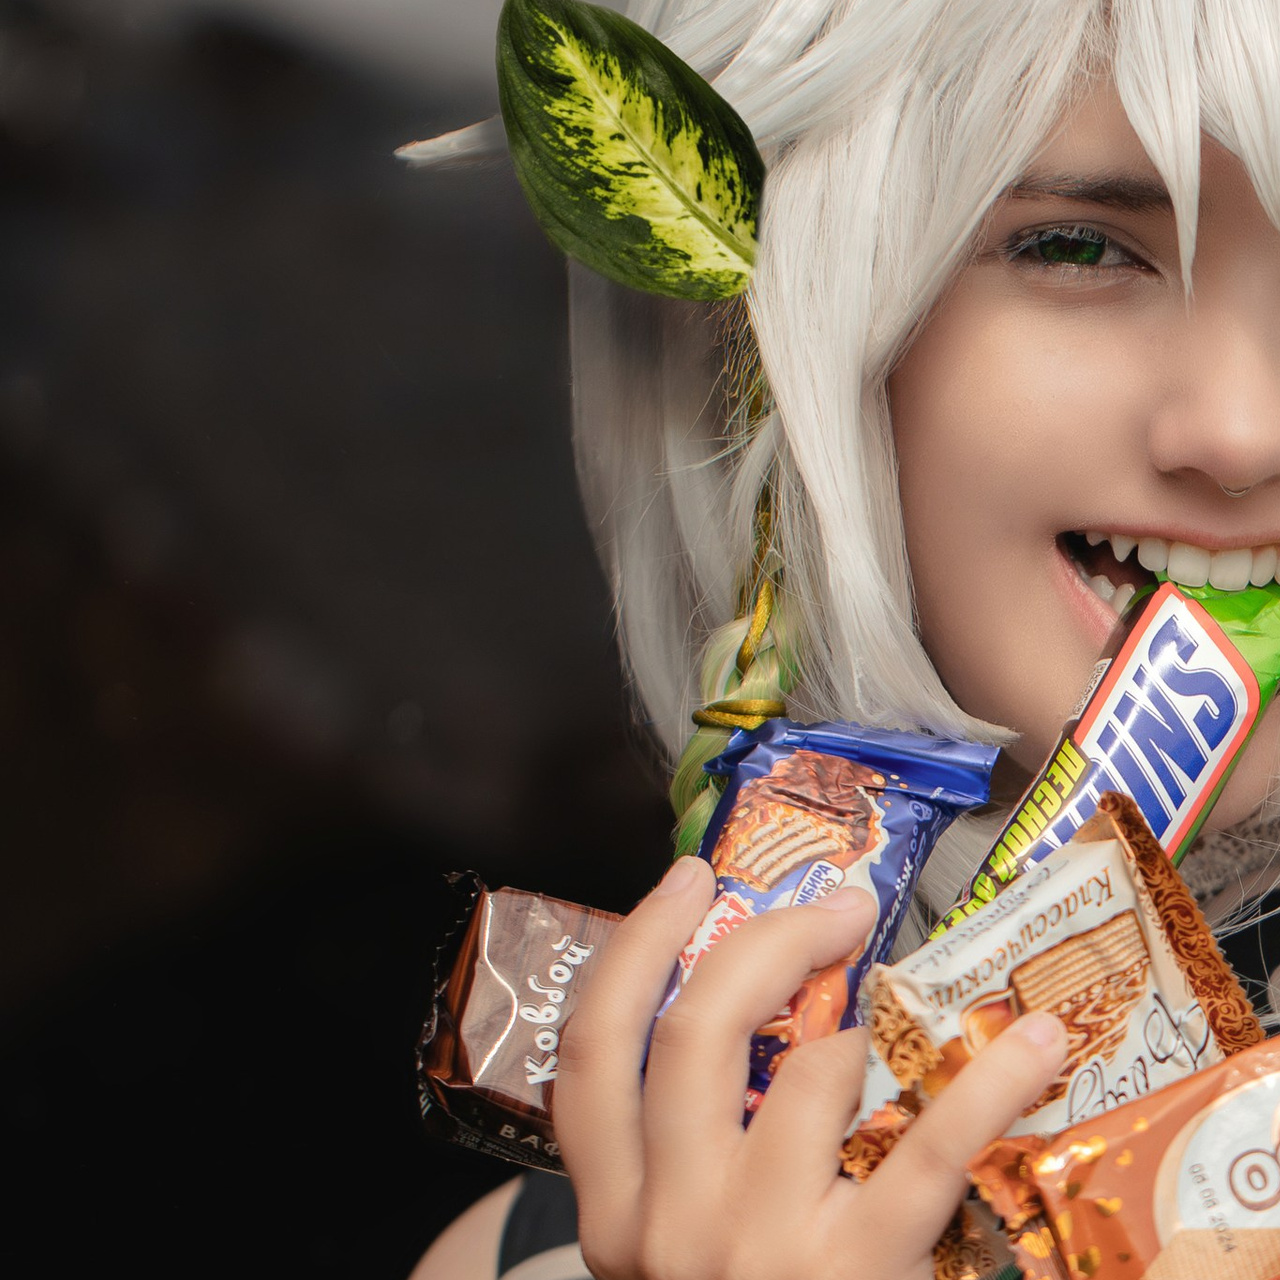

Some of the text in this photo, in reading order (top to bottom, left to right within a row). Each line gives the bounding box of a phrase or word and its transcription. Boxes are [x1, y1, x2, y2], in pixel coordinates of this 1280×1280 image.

[795, 862, 833, 907] МБИРА
[989, 738, 1087, 883] ЛЕСНОЙ
[519, 934, 595, 1086] Ковбой
[927, 865, 1115, 1021] Классический
